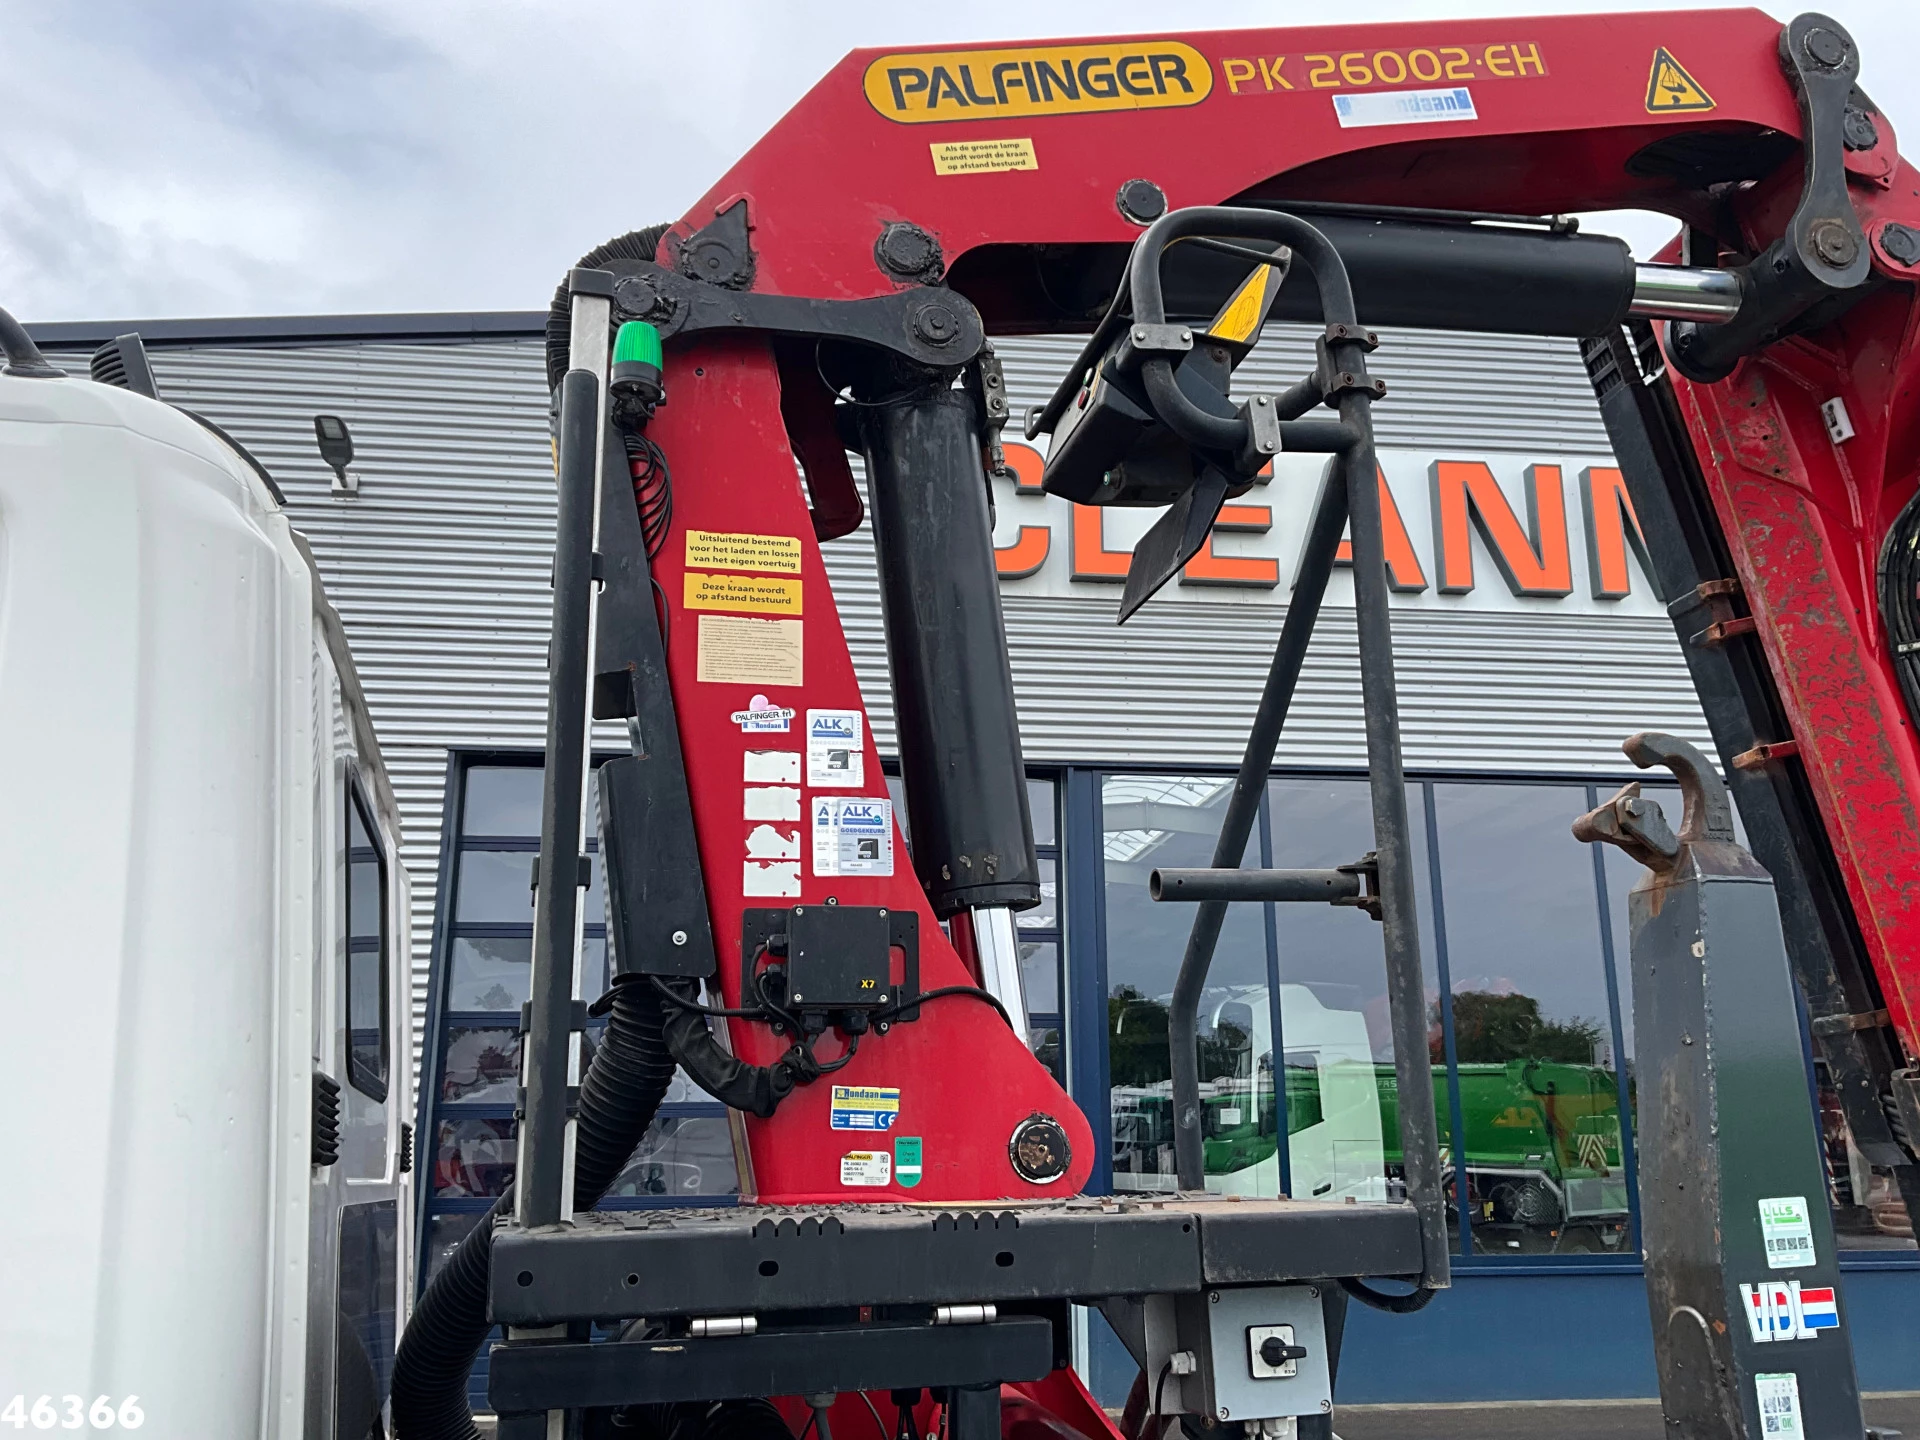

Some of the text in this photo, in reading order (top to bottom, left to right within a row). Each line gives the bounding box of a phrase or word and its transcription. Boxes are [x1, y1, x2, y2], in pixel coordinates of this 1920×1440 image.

[1222, 57, 1294, 93] PK
[887, 54, 1194, 110] PALFINGER
[971, 143, 998, 152] groene
[1000, 142, 1020, 150] lamp
[940, 154, 967, 162] brandt
[1006, 150, 1028, 158] kraan
[960, 160, 989, 169] afstand
[991, 159, 1026, 168] bestuurd
[699, 534, 791, 547] Uitsluitend bestemd
[713, 545, 728, 554] het
[730, 546, 756, 555] laden
[772, 549, 800, 558] lossen
[712, 556, 728, 564] het
[730, 557, 755, 566] eigen
[758, 559, 796, 569] voertuig
[702, 582, 785, 595] Deze kraan wordt
[711, 592, 747, 602] afstand
[749, 594, 791, 605] bestuurd
[813, 718, 843, 730] ALK
[842, 805, 873, 817] ALK
[860, 979, 876, 989] X7
[1740, 1281, 1817, 1342] VDL
